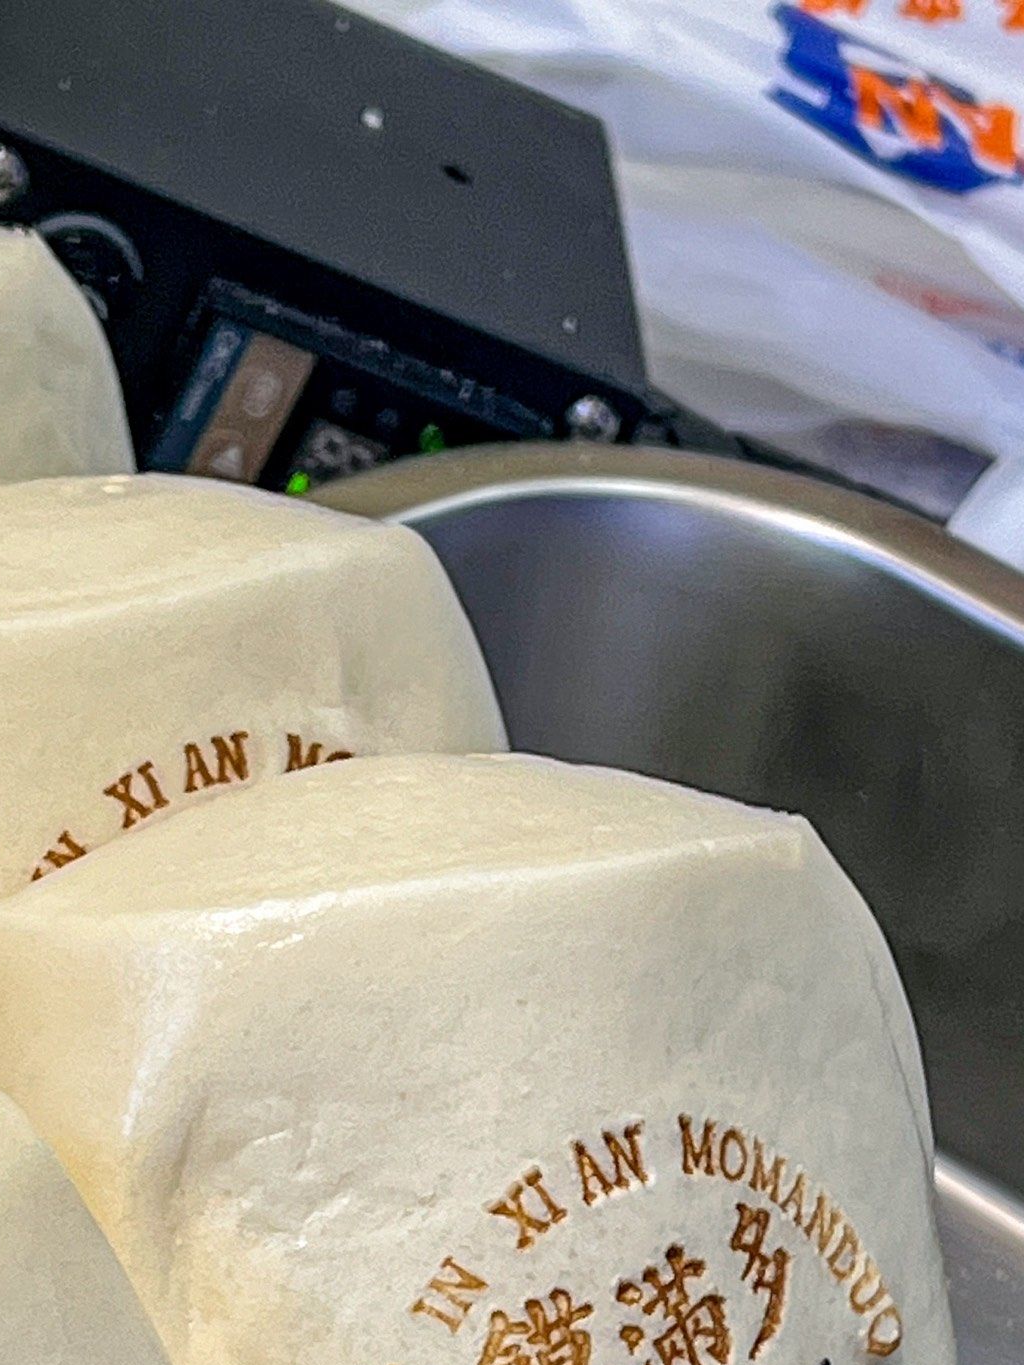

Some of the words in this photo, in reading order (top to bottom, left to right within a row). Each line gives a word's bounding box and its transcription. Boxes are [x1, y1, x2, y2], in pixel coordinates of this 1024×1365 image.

[103, 761, 170, 829] XI
[183, 731, 249, 793] AN
[411, 1257, 488, 1333] IN
[489, 1166, 567, 1250] XI
[571, 1121, 648, 1205] AN
[678, 1113, 903, 1357] MOMANDUO
